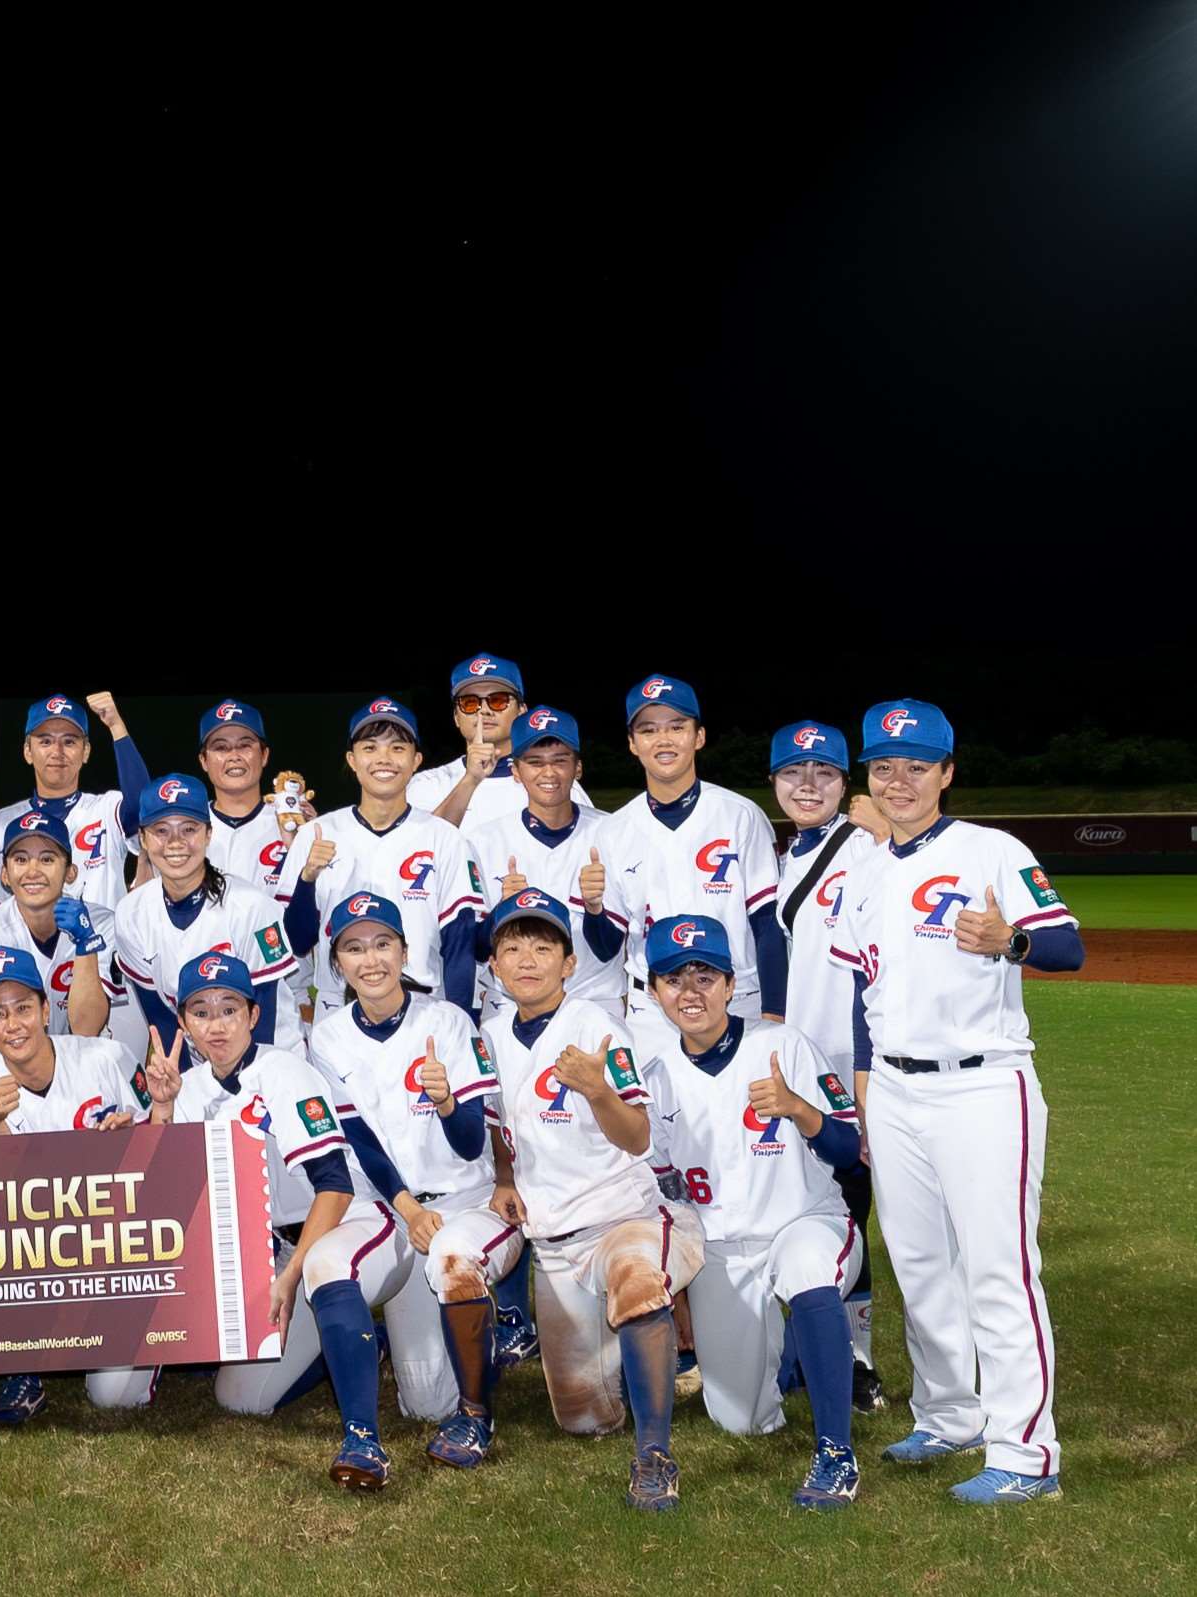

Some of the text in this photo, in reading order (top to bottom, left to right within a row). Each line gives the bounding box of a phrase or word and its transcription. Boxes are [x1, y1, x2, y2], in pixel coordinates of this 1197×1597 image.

[1079, 825, 1124, 841] Kowa
[39, 1280, 65, 1298] TO
[68, 1277, 106, 1296] THE
[110, 1273, 177, 1293] FINALS
[145, 1330, 188, 1345] @WBSC
